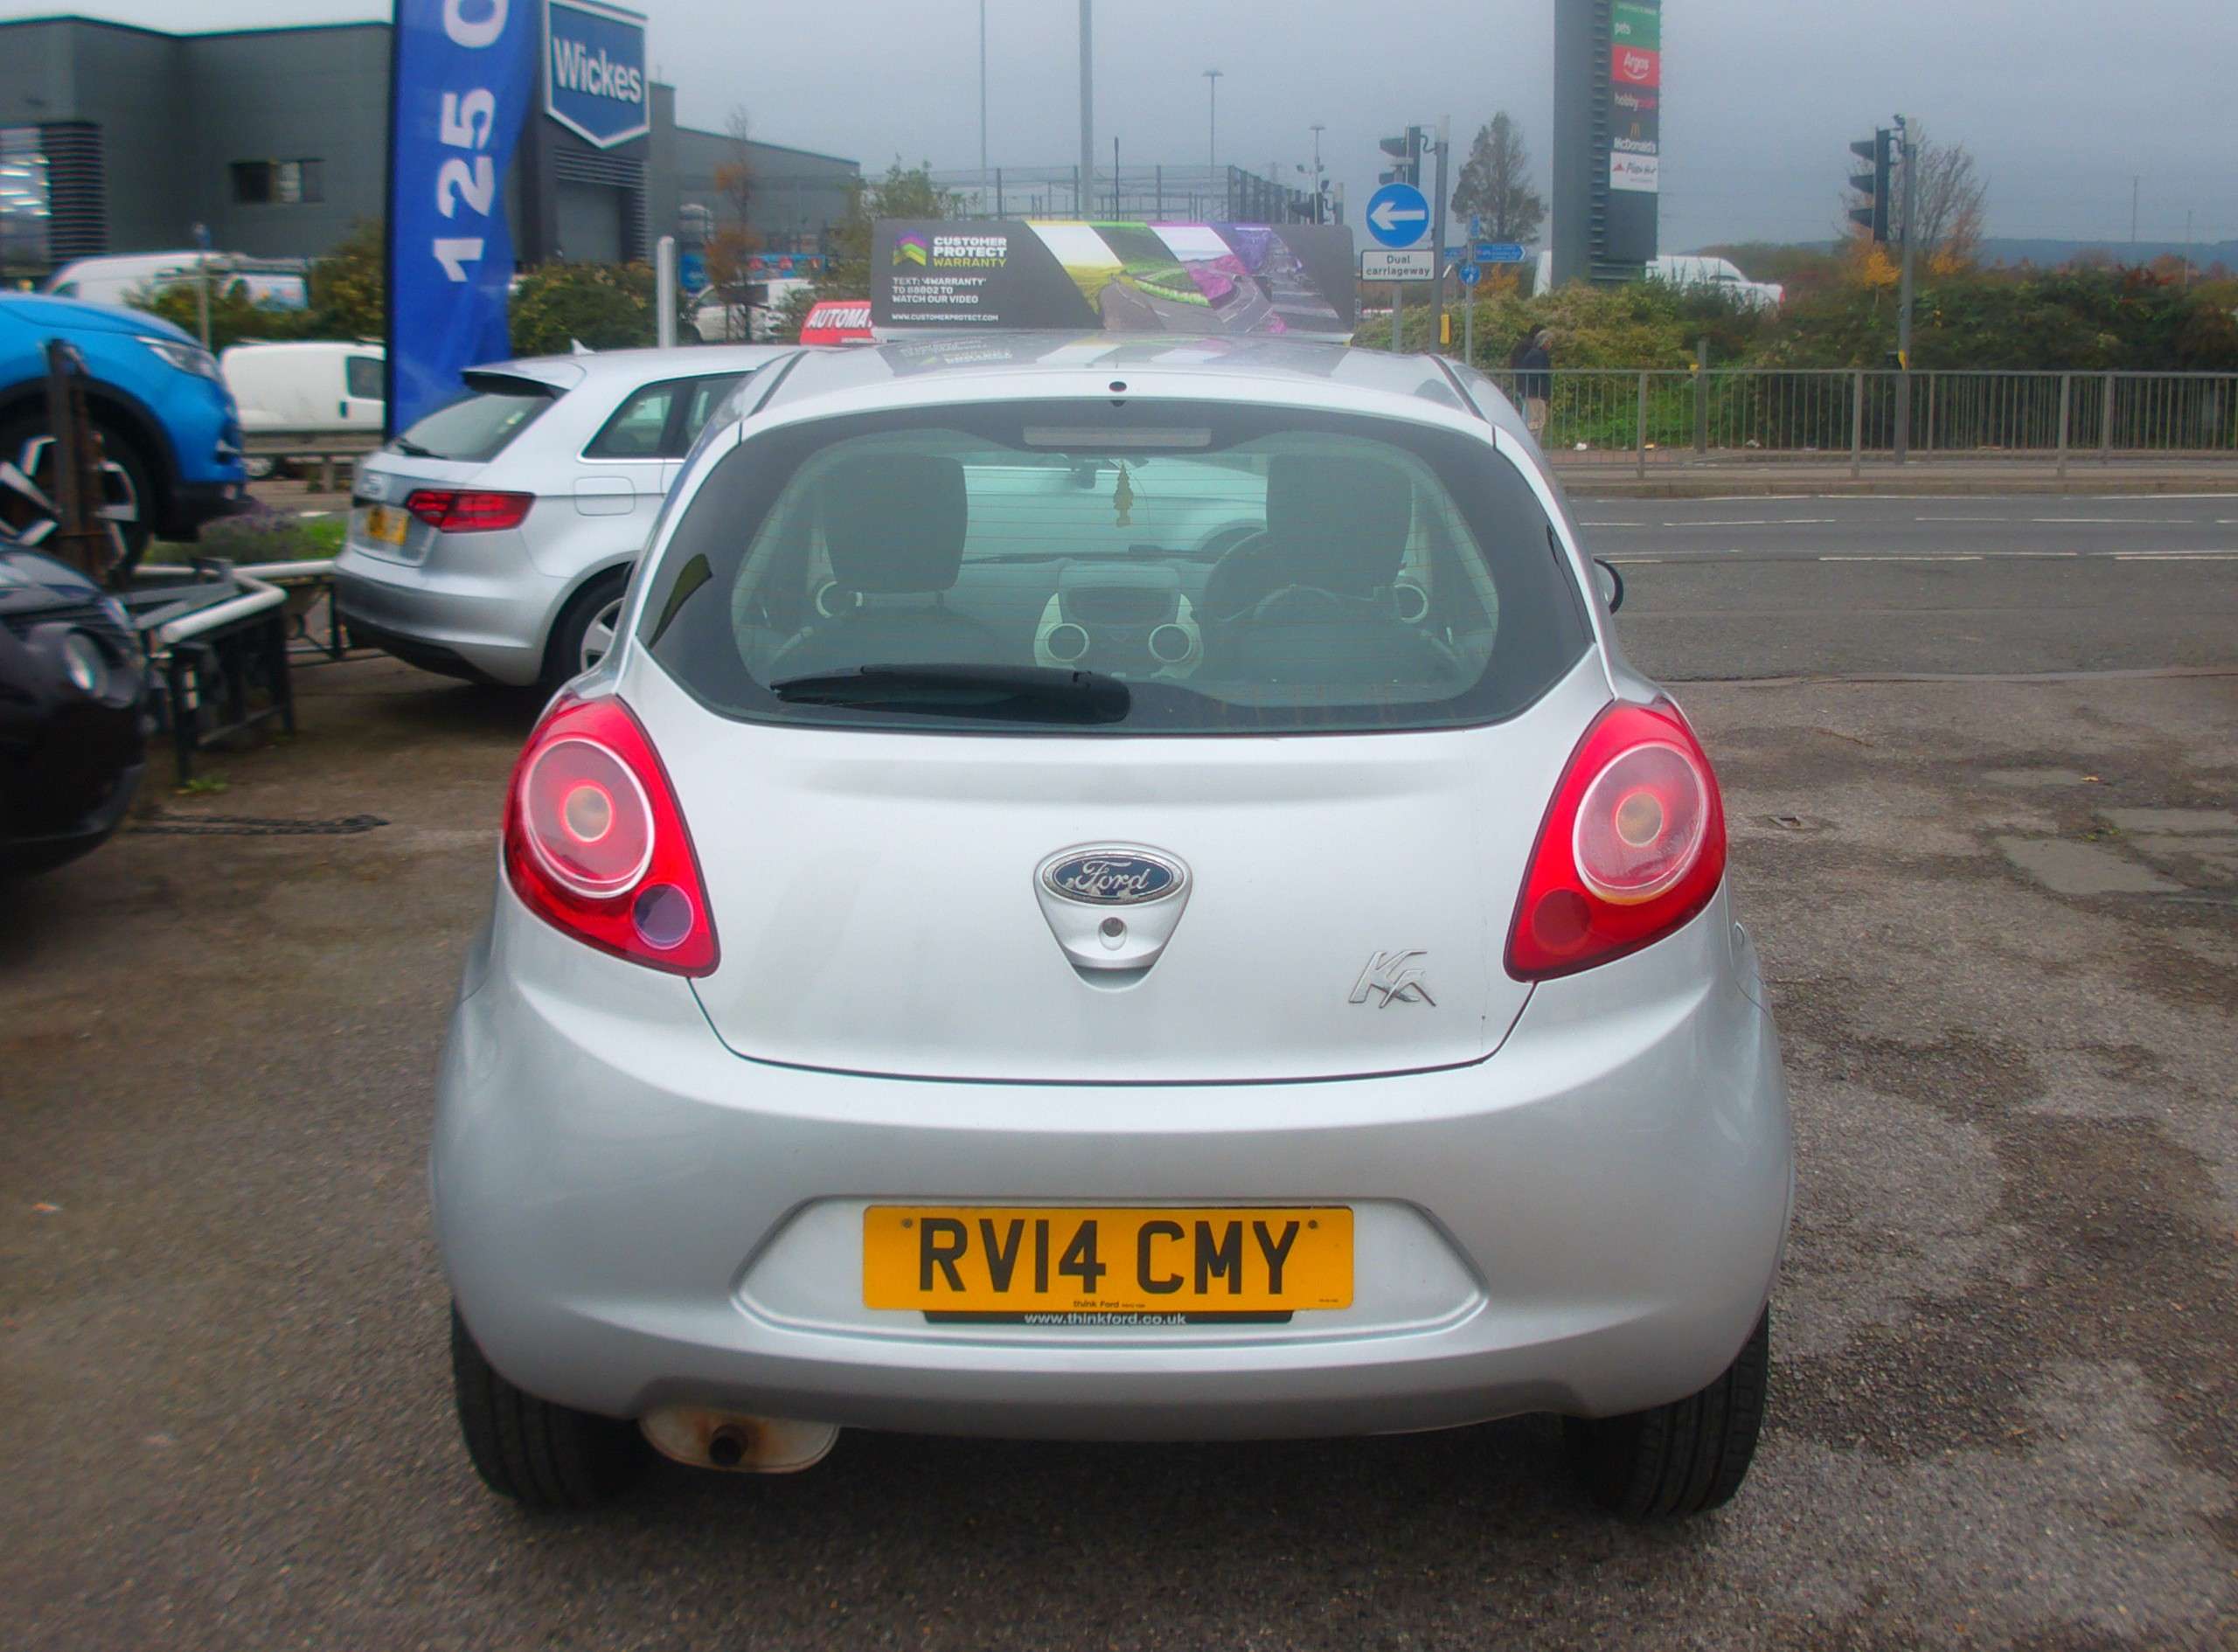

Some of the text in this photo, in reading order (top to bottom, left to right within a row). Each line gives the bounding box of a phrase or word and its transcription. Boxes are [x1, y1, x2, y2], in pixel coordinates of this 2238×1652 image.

[1623, 52, 1650, 73] Argos
[553, 38, 643, 104] Wickes
[1614, 137, 1657, 155] McDonald's
[433, 88, 496, 282] 125
[933, 237, 1007, 246] CUSTOMER
[933, 246, 1007, 257] PROTECT
[933, 258, 1006, 267] WARRANTY
[1387, 254, 1410, 264] Dual
[1366, 266, 1430, 279] carriageway
[893, 286, 905, 295] TO
[941, 287, 953, 295] TO
[892, 295, 978, 304] WATCH OUR VIDEO
[808, 309, 872, 329] AUTOMA
[891, 313, 999, 323] WWW.CUSTOMERPROTECT.COM
[1075, 860, 1152, 890] Ford
[1348, 949, 1436, 1009] Ka
[919, 1218, 1301, 1295] RV14 CMY
[1099, 1300, 1120, 1308] Ford
[1024, 1312, 1187, 1326] www.thinkford.co.uk
